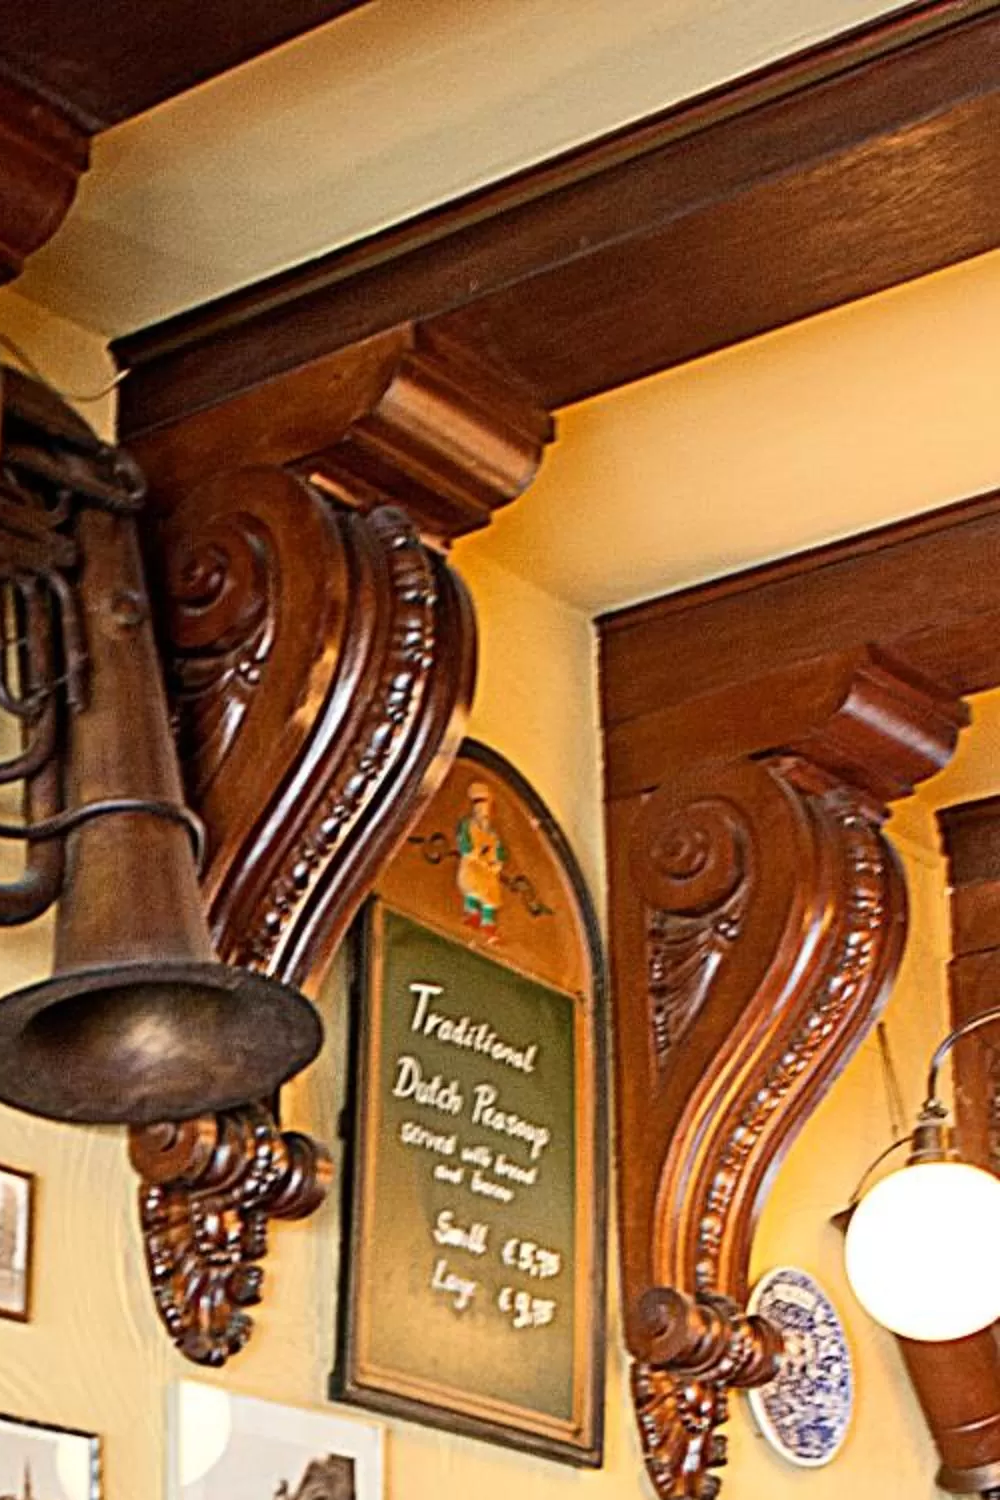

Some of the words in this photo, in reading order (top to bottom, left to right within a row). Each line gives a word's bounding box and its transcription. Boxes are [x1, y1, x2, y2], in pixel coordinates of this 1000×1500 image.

[409, 983, 537, 1072] Traditional
[392, 1056, 463, 1115] Dutch
[472, 1083, 549, 1160] Peasoup
[401, 1121, 458, 1155] served
[494, 1153, 538, 1184] bread
[433, 1165, 464, 1183] and
[432, 1210, 488, 1254] Small
